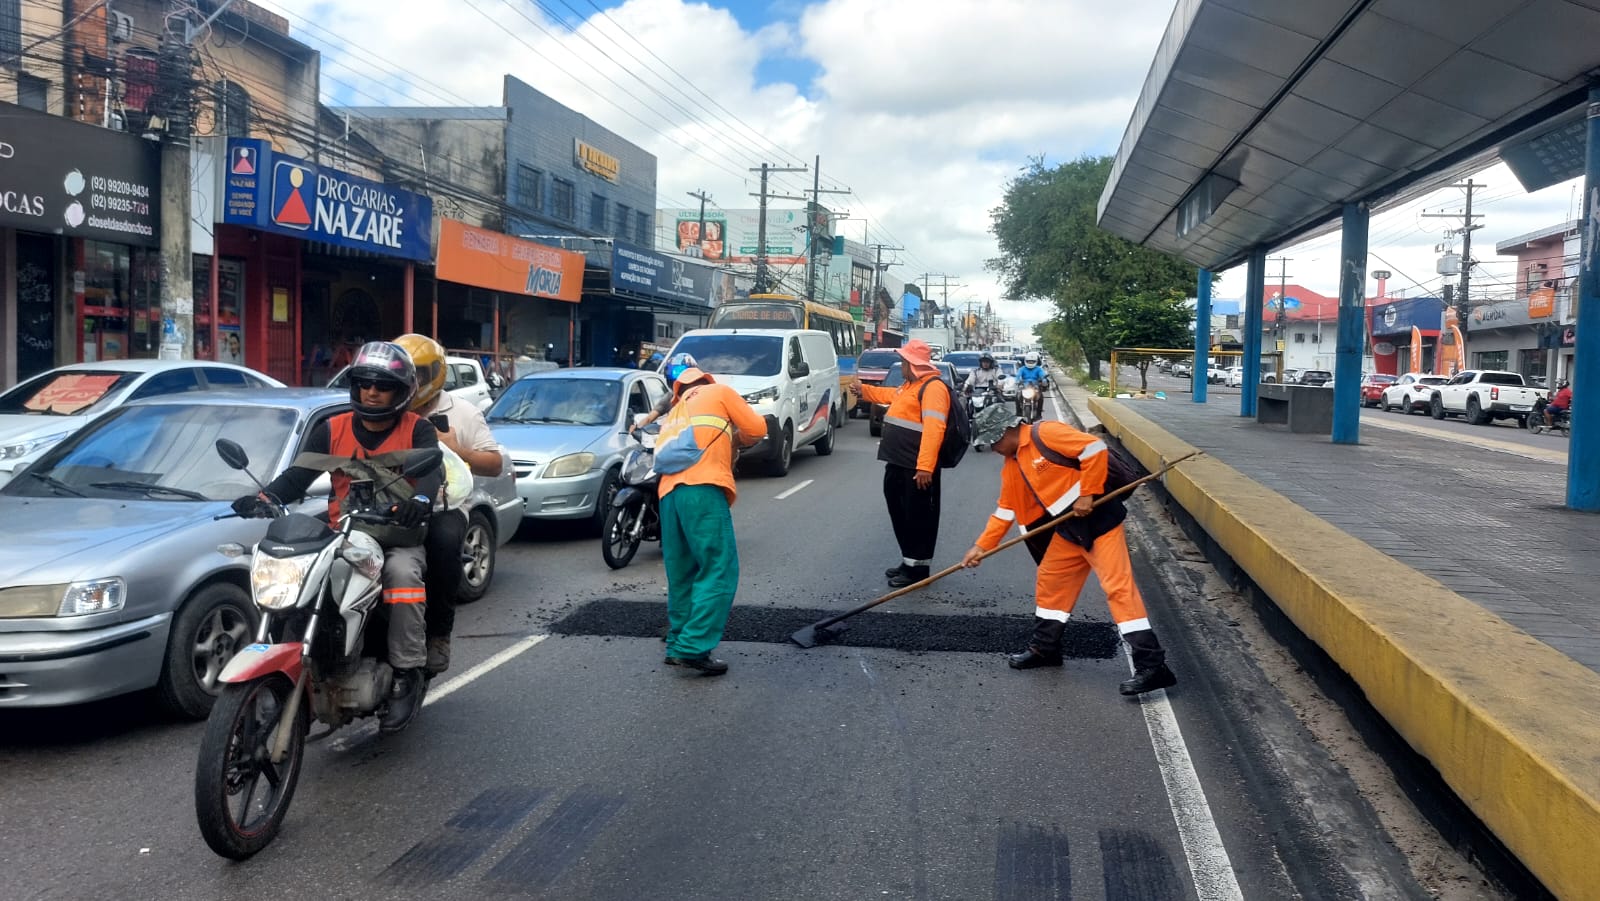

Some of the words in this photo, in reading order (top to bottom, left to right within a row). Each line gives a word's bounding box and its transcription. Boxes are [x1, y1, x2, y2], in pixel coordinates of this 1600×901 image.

[91, 176, 107, 192] (92)
[317, 174, 396, 215] DROGARIAS
[91, 194, 107, 211] (92)
[314, 197, 403, 249] NAZARÉ
